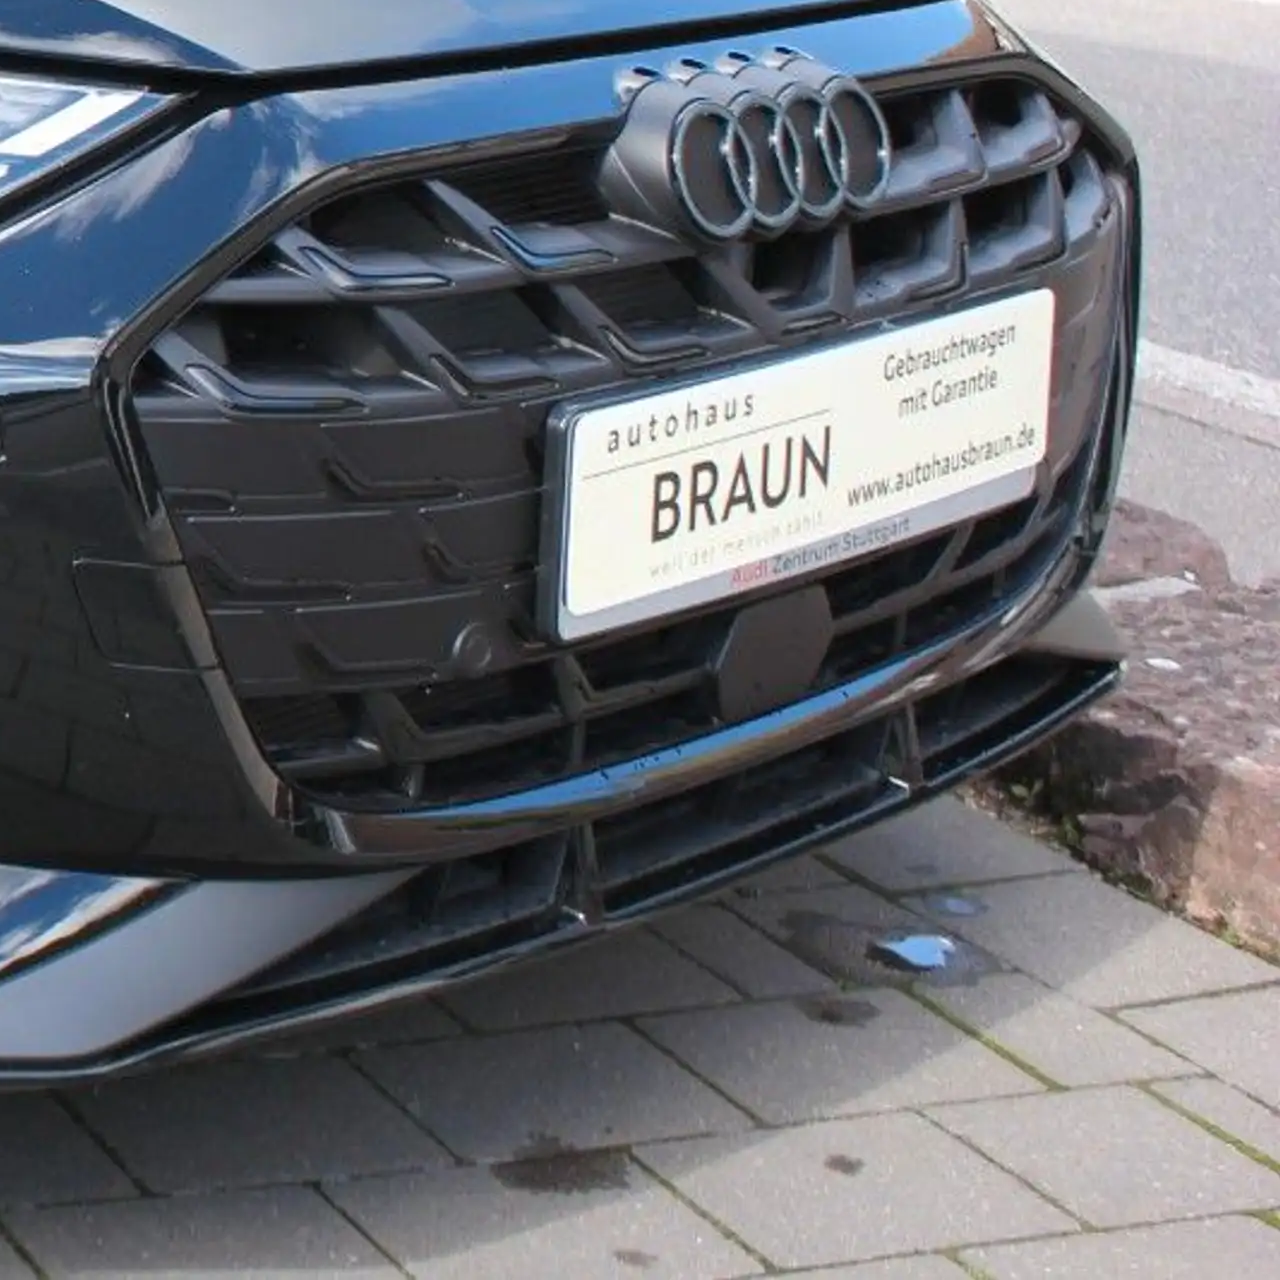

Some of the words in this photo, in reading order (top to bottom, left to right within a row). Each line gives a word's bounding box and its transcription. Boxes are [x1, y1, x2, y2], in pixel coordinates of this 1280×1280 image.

[883, 324, 1017, 383] Gebrauchtwagen
[606, 393, 756, 454] autohaus
[897, 386, 928, 418] mit
[931, 365, 998, 408] Garantie
[651, 424, 832, 543] BRAUN
[846, 422, 1037, 508] www.autohausbraun.de
[731, 565, 769, 587] Audi
[771, 545, 840, 576] Zentrum
[842, 517, 911, 552] Stuttgart
